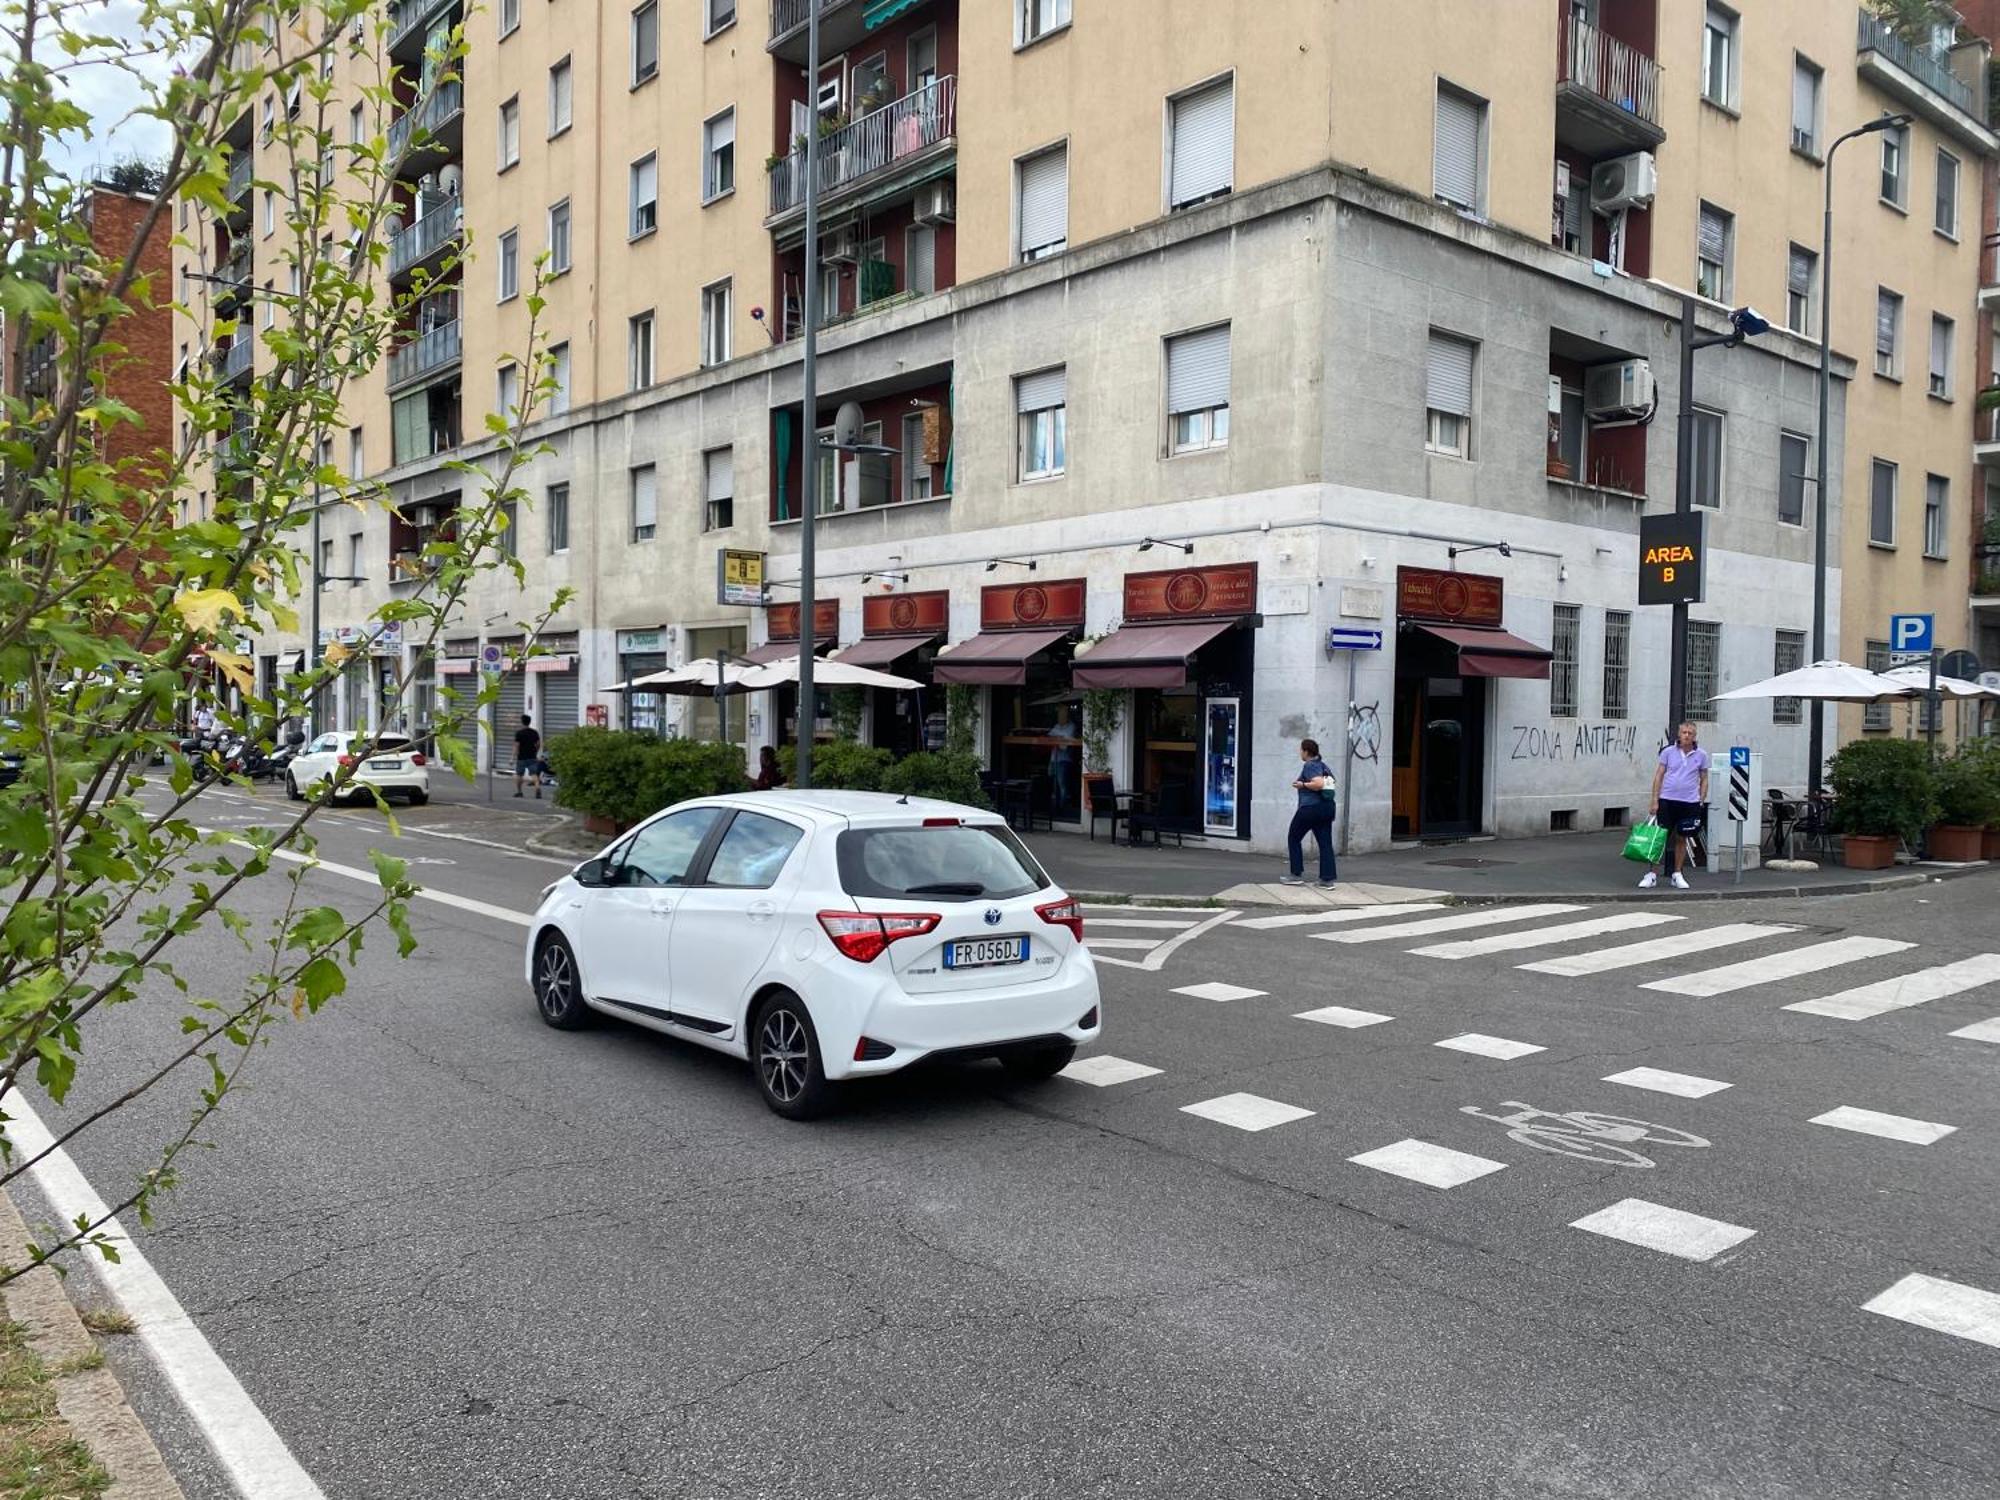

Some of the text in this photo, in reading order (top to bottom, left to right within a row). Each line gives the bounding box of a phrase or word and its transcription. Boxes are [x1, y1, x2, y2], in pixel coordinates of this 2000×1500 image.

[1645, 546, 1694, 563] AREA
[1663, 567, 1674, 582] B
[1897, 618, 1926, 649] P
[1511, 725, 1563, 760] ZONA
[955, 940, 1021, 964] FR 056DJ
